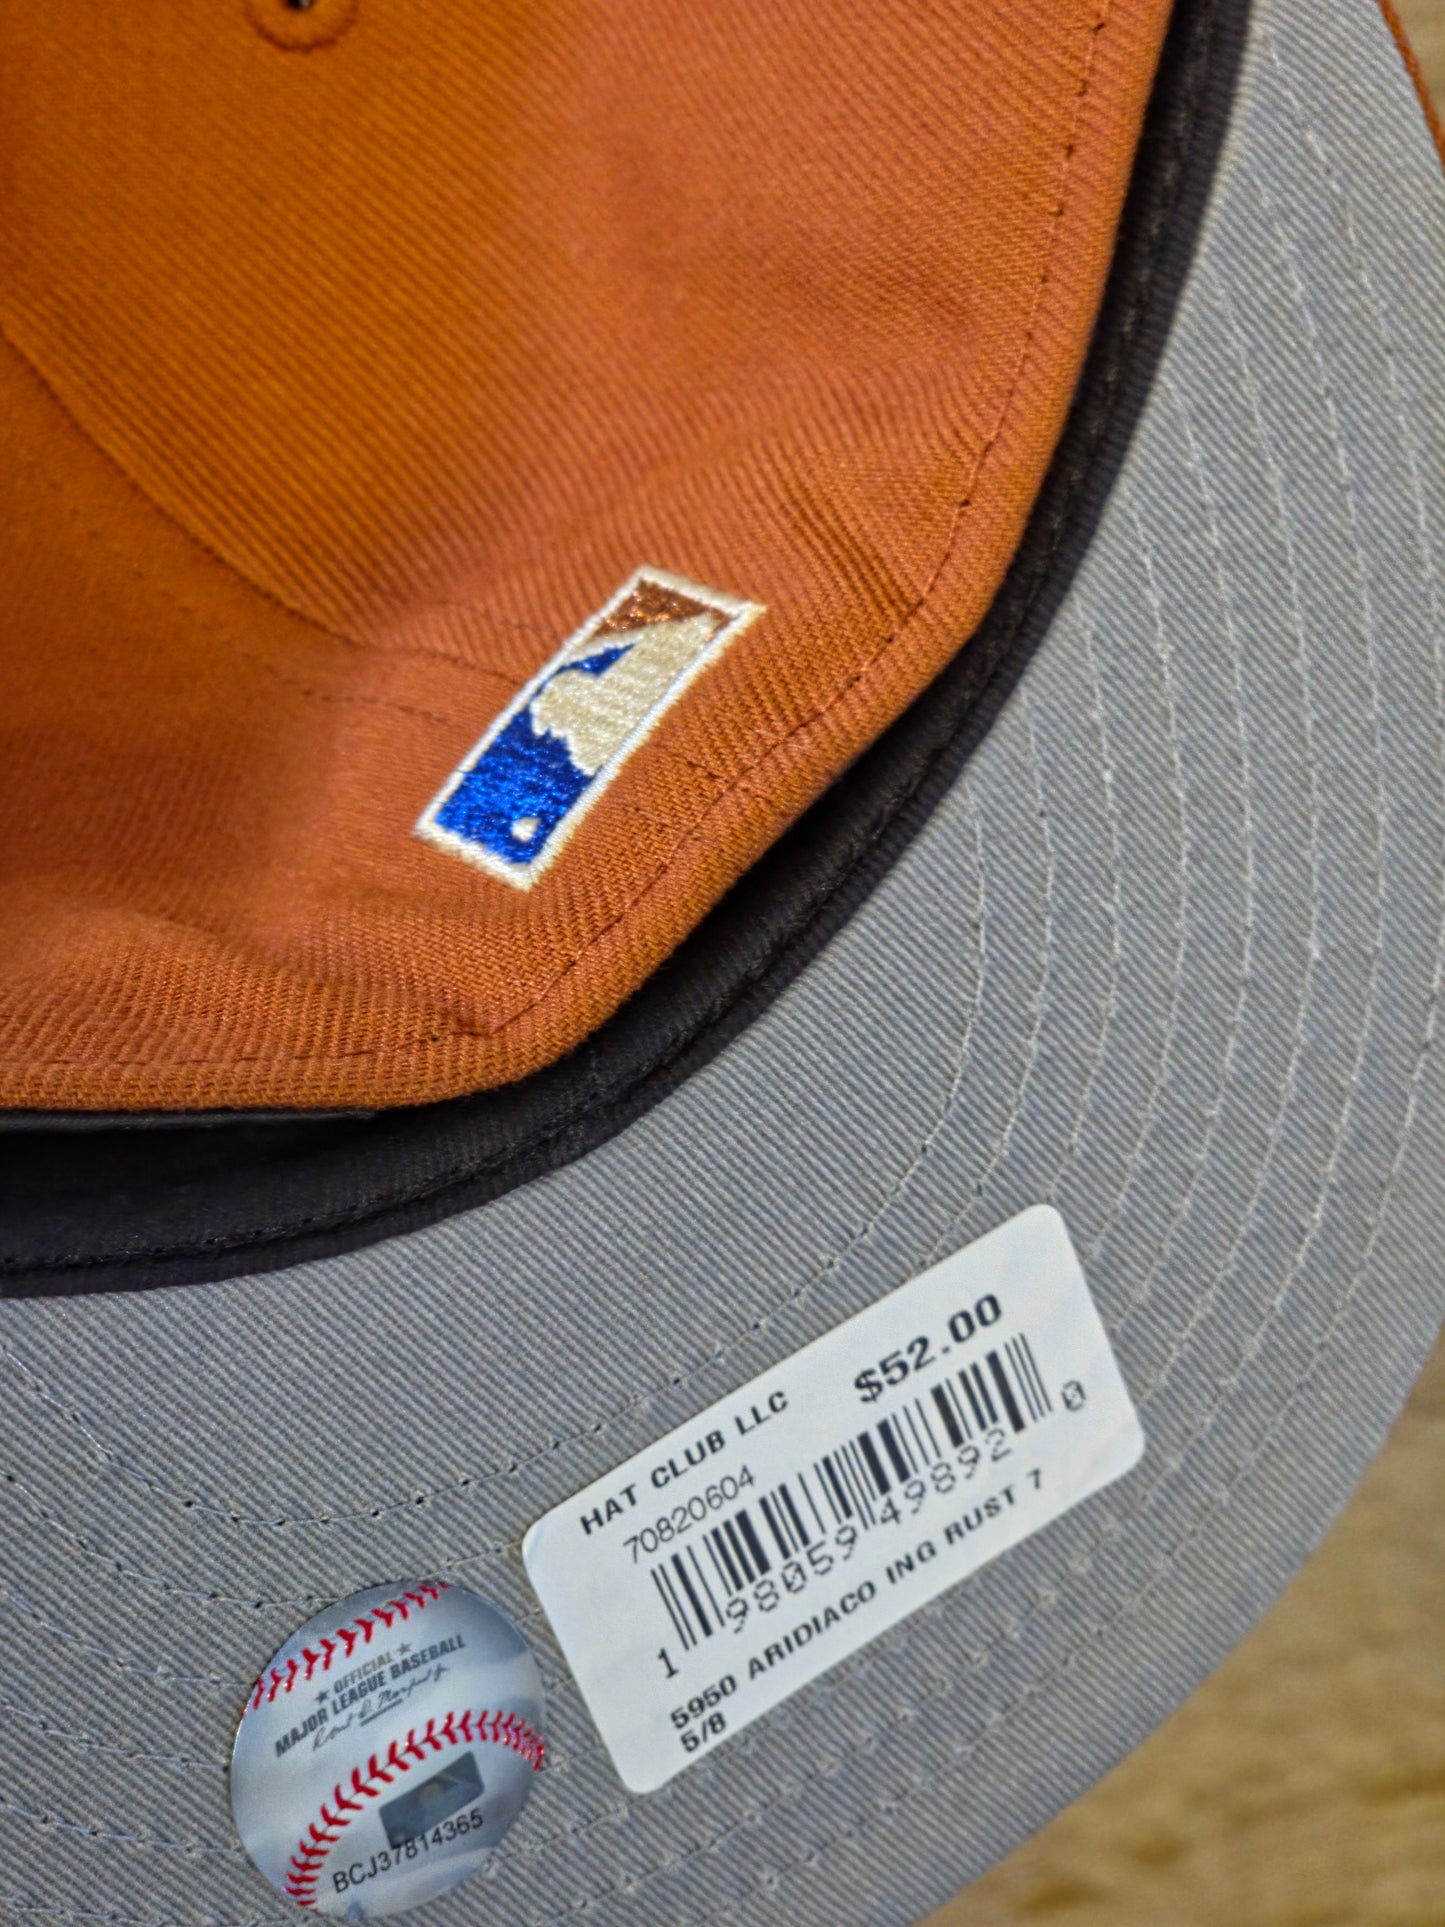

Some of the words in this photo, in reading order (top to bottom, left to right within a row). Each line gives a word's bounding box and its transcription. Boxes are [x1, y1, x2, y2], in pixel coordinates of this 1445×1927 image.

[854, 1293, 1002, 1403] $52.00
[580, 1483, 637, 1535] HAT
[650, 1430, 725, 1489] CLUB
[734, 1391, 788, 1435] LLC
[622, 1464, 755, 1564] 70820604
[670, 1674, 737, 1730] 5950
[748, 1580, 877, 1681] ARIDIACO
[944, 1485, 1016, 1545] RUST
[1027, 1467, 1042, 1490] 7
[274, 1707, 329, 1758] MAJOR
[331, 1672, 387, 1716] LEAGUE
[390, 1634, 467, 1679] BASEBALL
[333, 1651, 395, 1694] OFFICIAL
[658, 1647, 679, 1679] 1
[679, 1711, 727, 1753] 5/8
[332, 1808, 484, 1894] BCJ37814365
